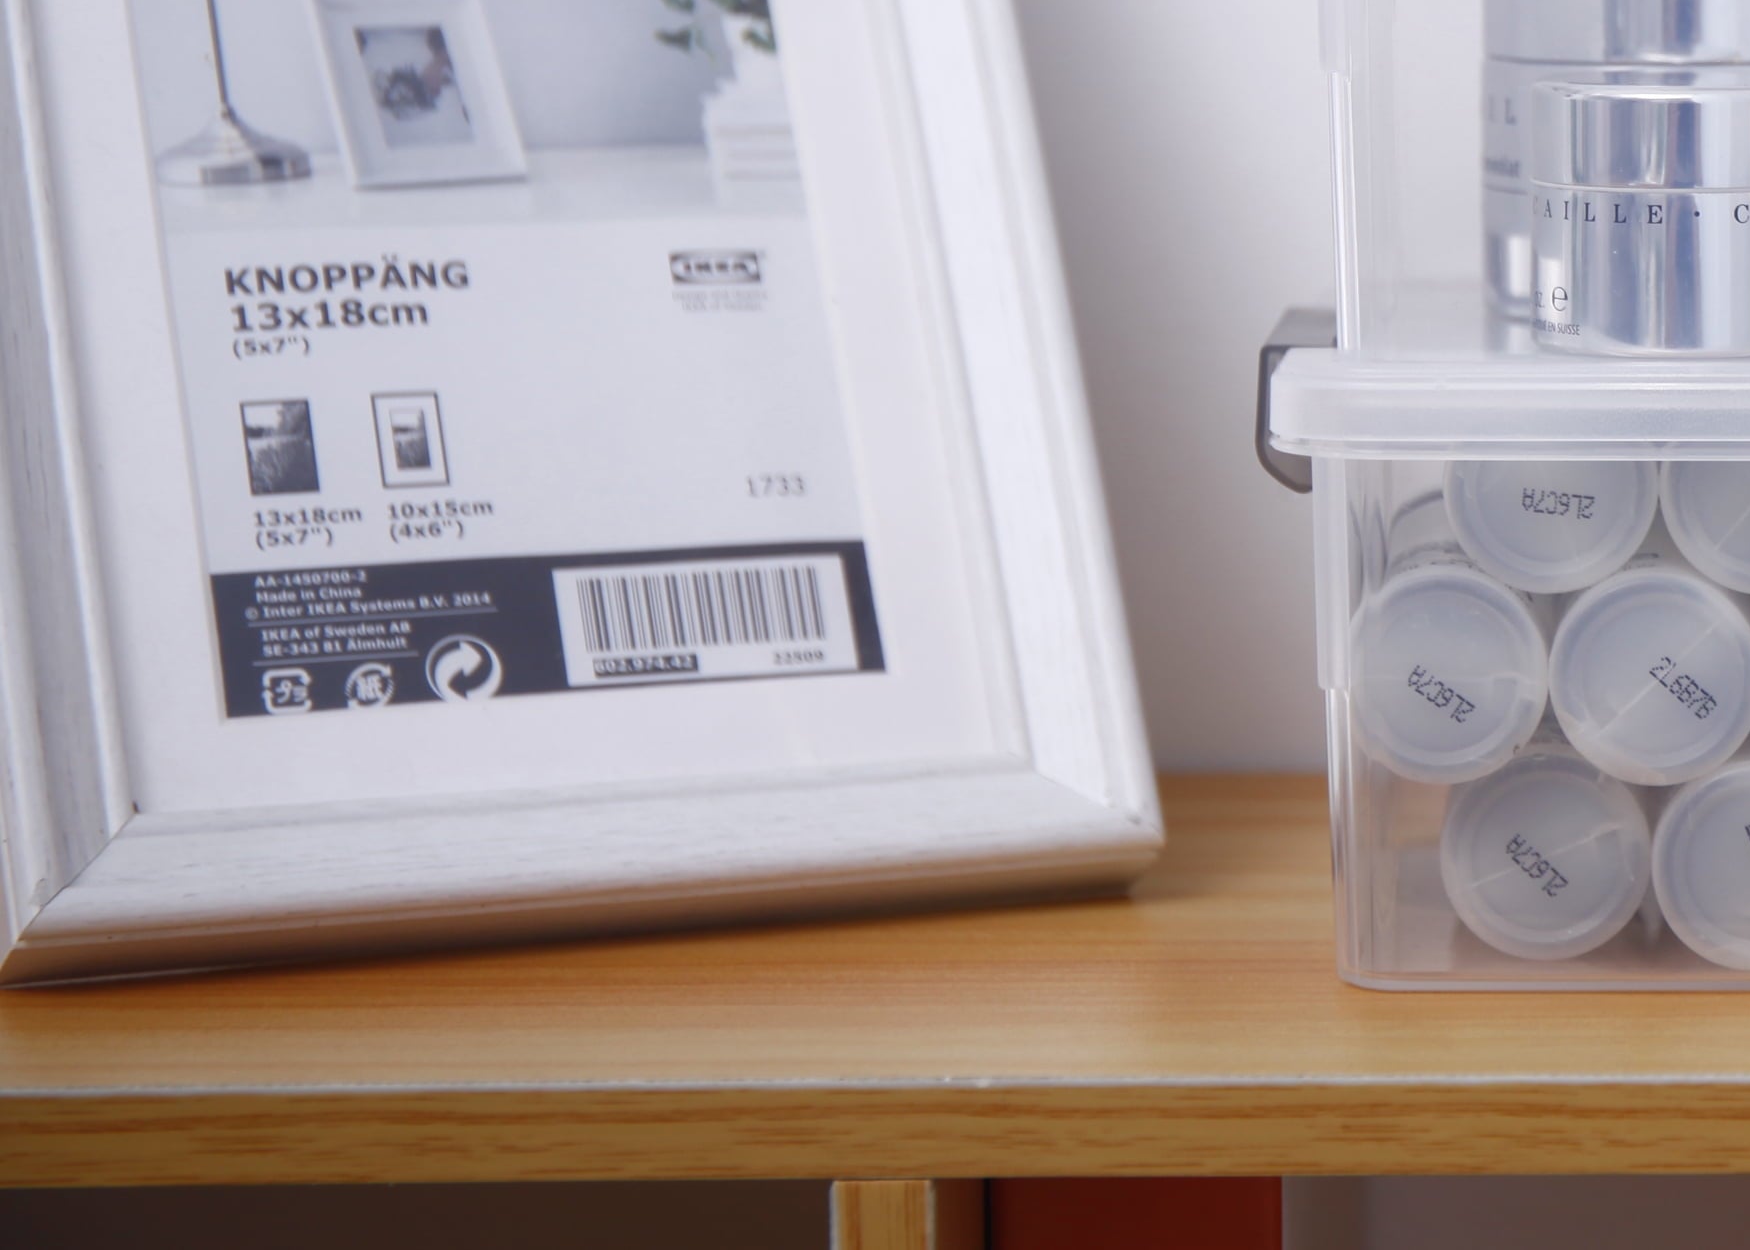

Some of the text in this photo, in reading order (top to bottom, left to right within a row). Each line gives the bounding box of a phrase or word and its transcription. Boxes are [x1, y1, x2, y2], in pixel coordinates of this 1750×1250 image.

[224, 253, 470, 295] KNOPPÄNG
[231, 297, 429, 333] 13x18cm
[232, 336, 311, 360] (5x7")
[745, 471, 806, 498] 1733
[387, 498, 494, 521] 10x15cm
[1521, 487, 1596, 520] 2L6C7A
[253, 507, 363, 528] 13x18cm
[255, 526, 333, 551] (5x7")
[254, 587, 363, 603] Made in China
[262, 605, 303, 619] Inter
[306, 601, 347, 616] IKEA
[349, 597, 416, 615] Systems
[260, 619, 411, 643] IKEA of Sweden AB
[1407, 664, 1477, 724] 2L6C7A
[1505, 833, 1570, 898] 2L6C7A
